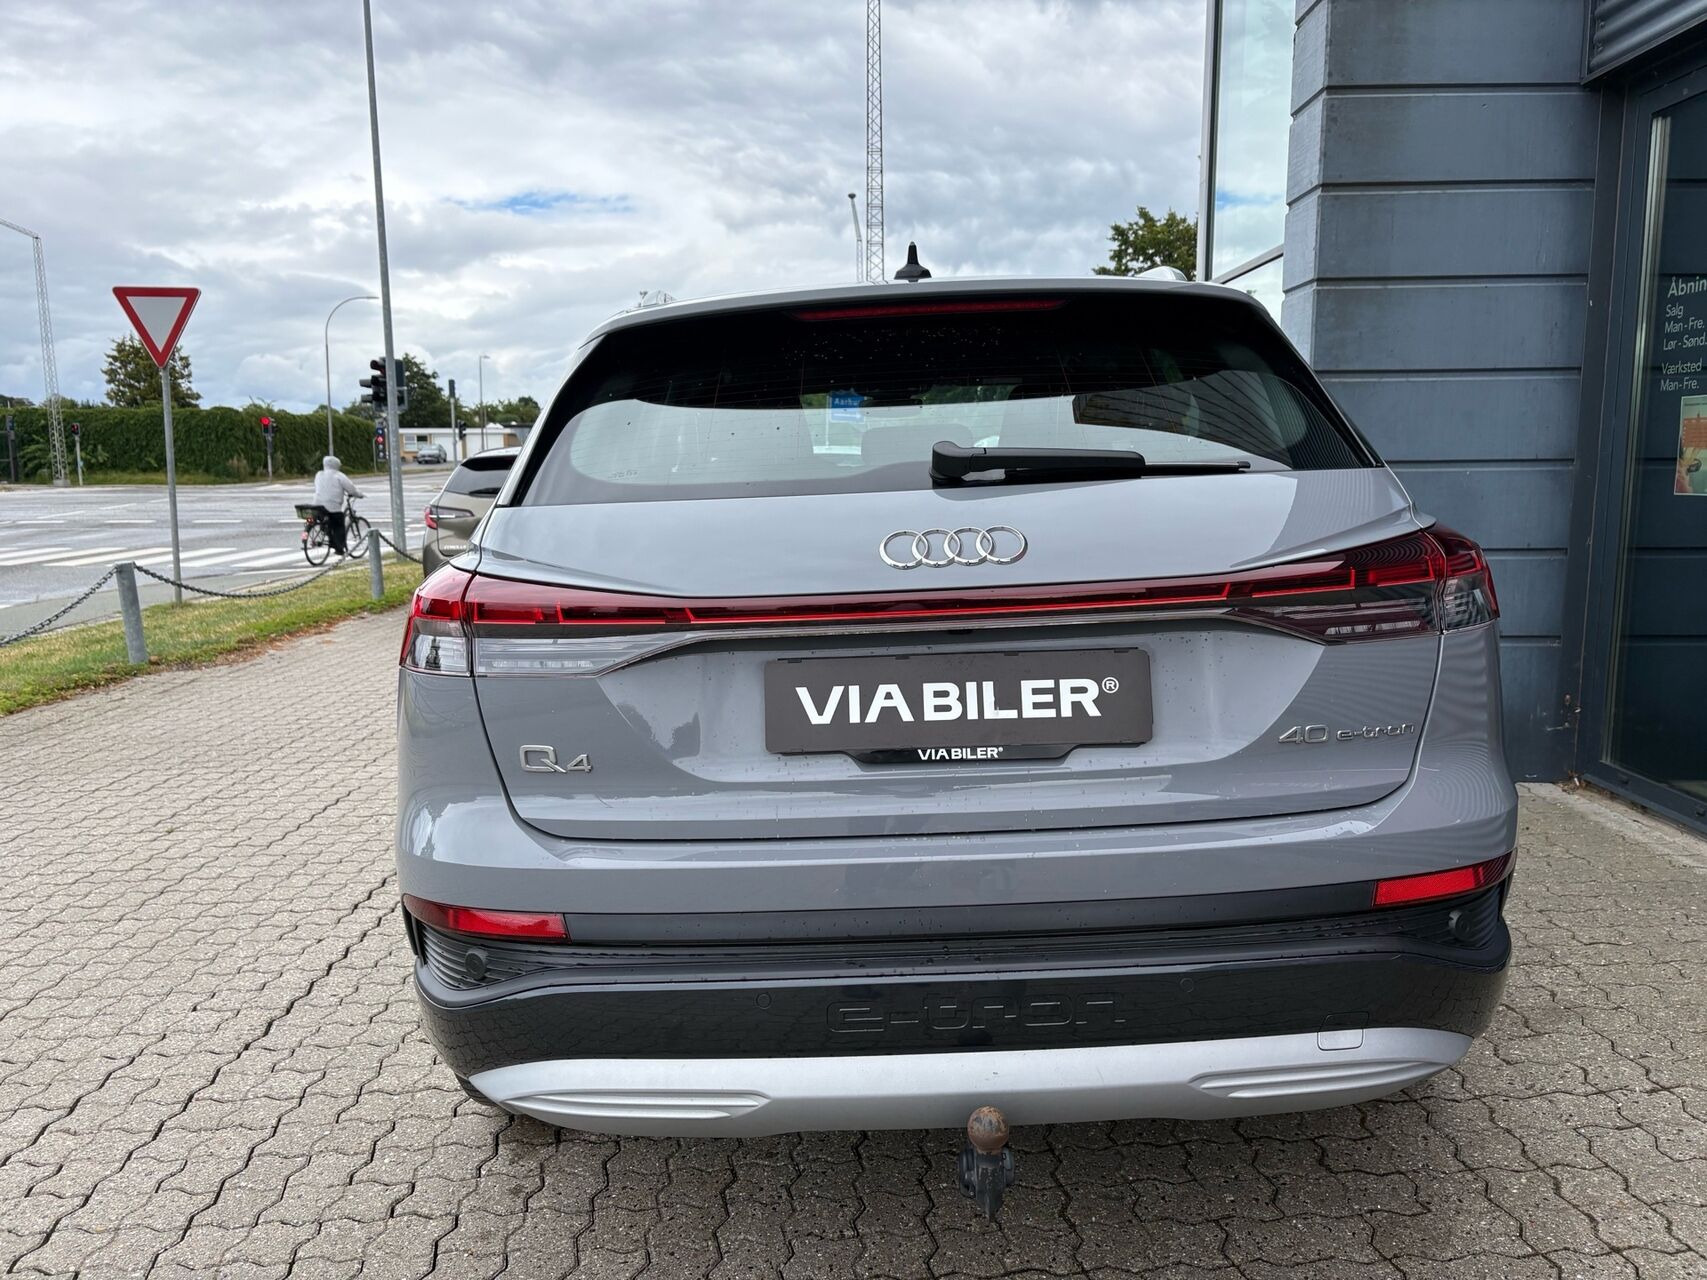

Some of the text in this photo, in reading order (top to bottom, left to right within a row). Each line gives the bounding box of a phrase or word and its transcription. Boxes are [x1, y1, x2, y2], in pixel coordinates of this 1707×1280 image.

[1665, 303, 1684, 318] Salg
[1661, 358, 1703, 375] Værksted
[1278, 723, 1414, 744] 40 e-tron
[520, 744, 592, 773] Q4
[826, 993, 1127, 1032] e-tron
